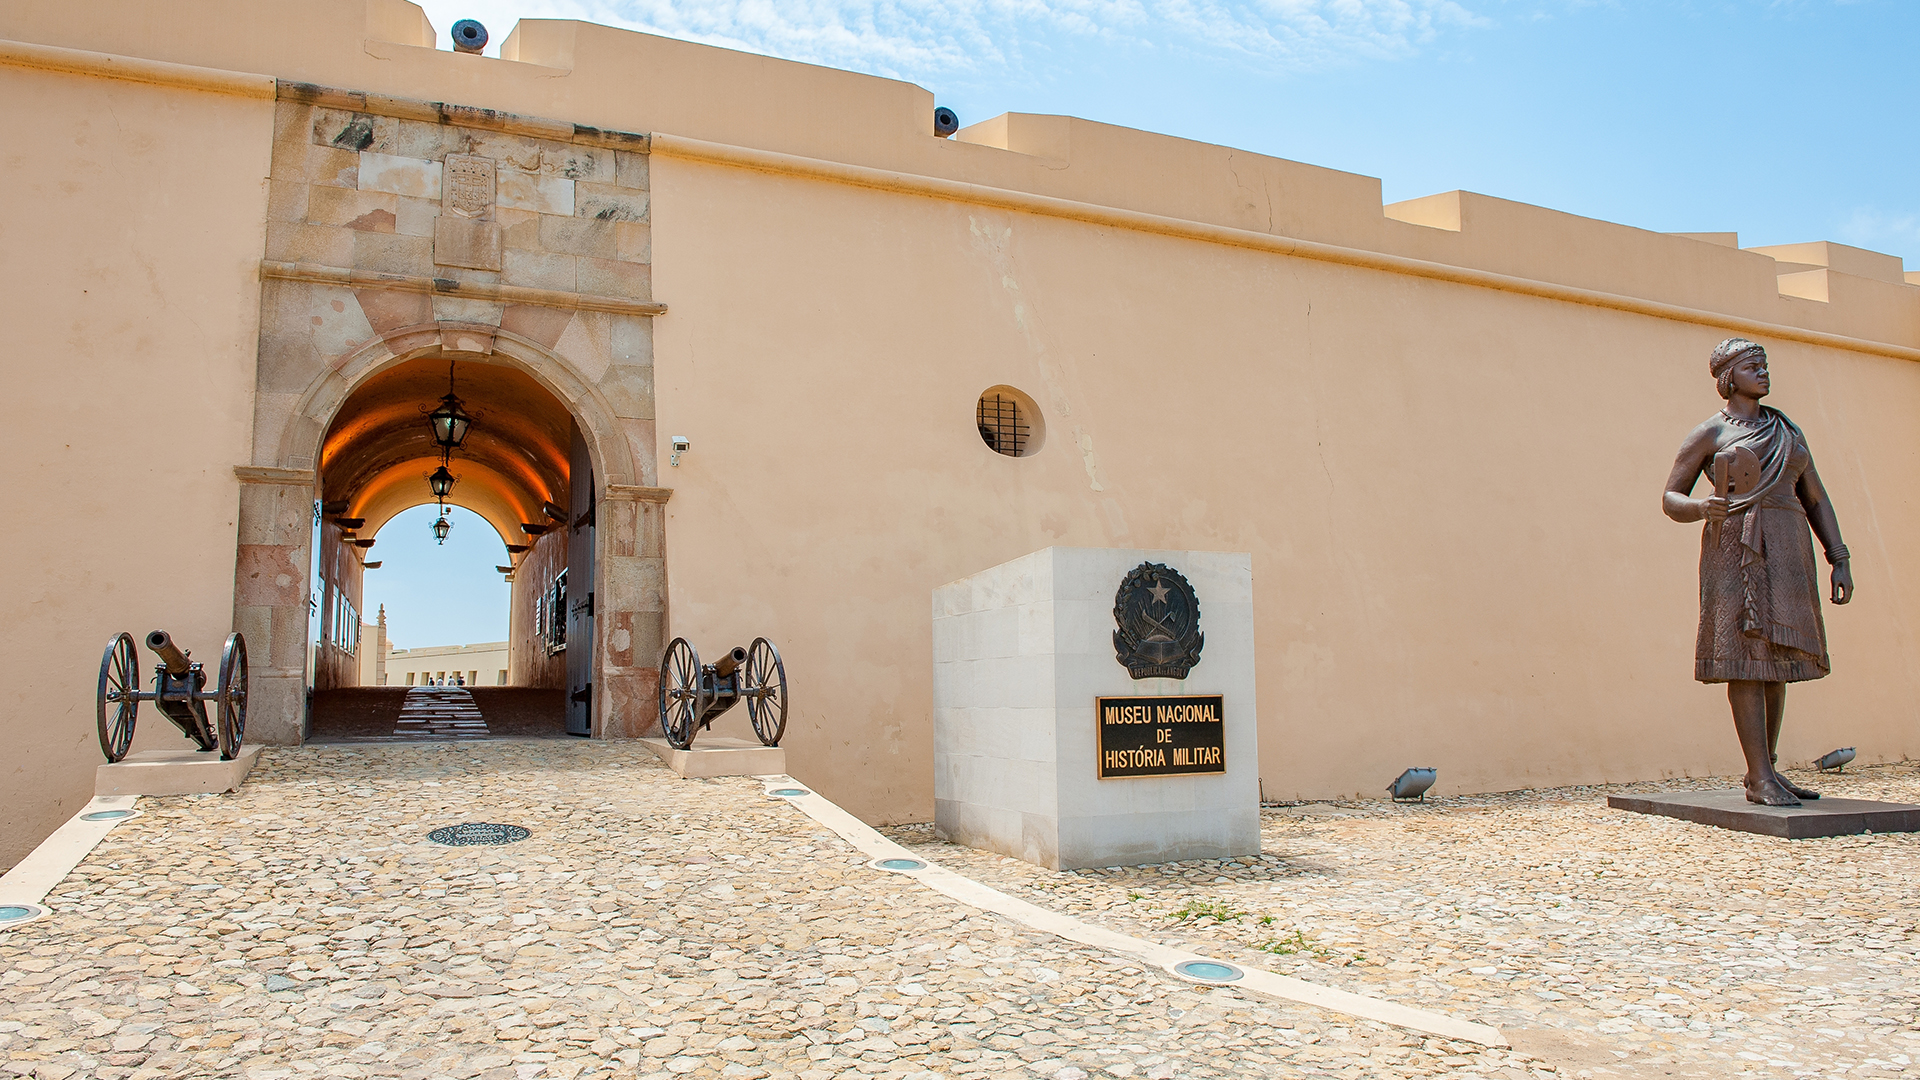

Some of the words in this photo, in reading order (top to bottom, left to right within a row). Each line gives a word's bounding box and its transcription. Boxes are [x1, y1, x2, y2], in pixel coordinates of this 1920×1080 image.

[1105, 706, 1152, 724] MUSEU
[1156, 705, 1220, 723] NACIONAL
[1156, 729, 1172, 743] DE
[1105, 745, 1166, 768] HISTÓRIA
[1173, 747, 1221, 765] MILITAR
